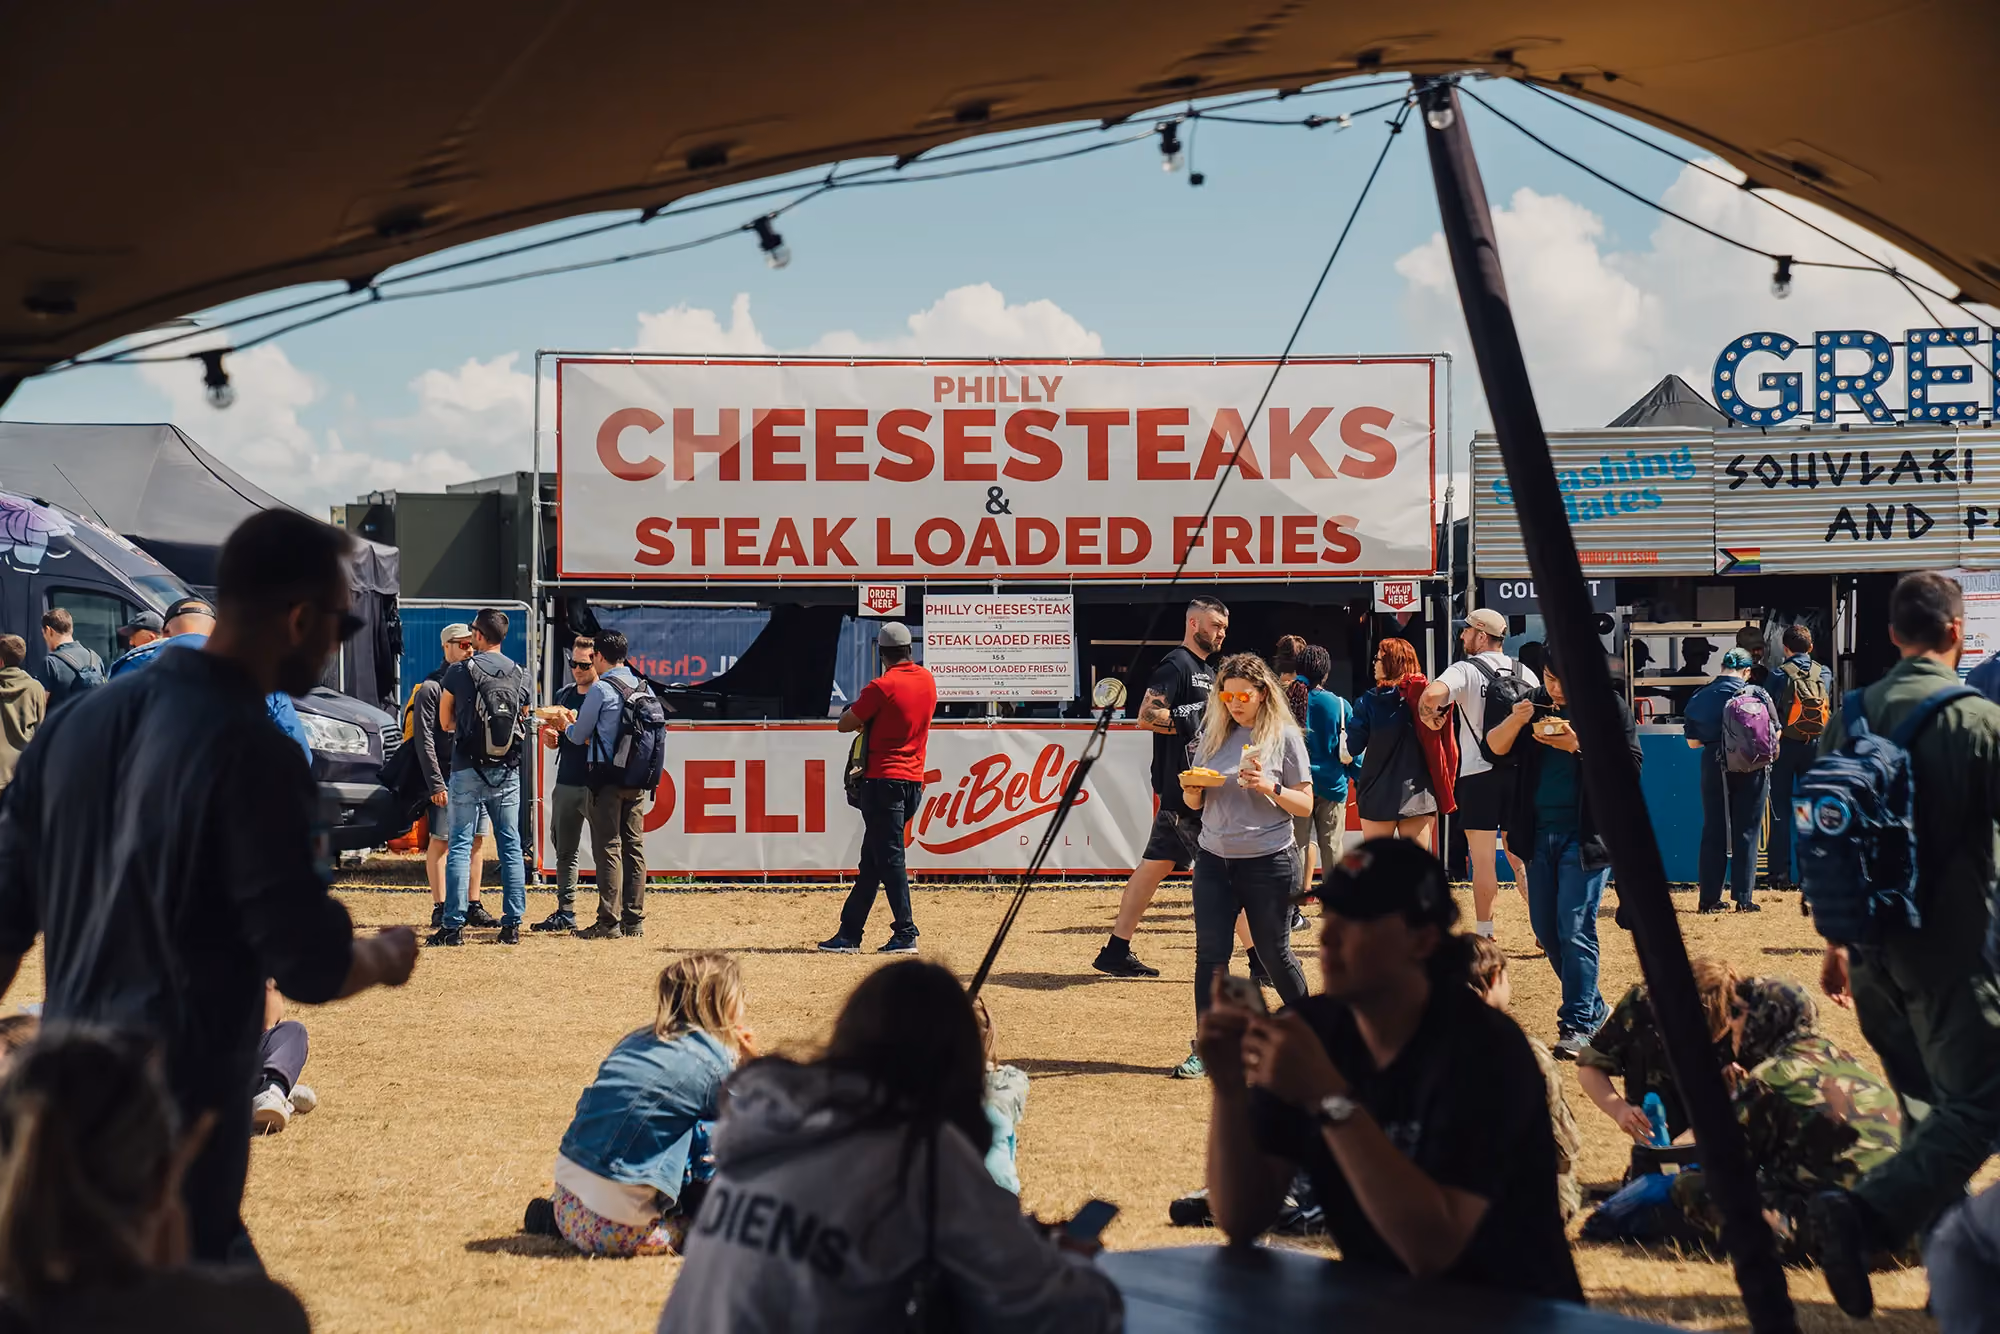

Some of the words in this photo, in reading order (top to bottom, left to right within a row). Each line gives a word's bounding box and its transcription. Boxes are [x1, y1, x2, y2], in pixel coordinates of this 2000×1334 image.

[934, 376, 1062, 403] PHILLY
[1713, 327, 2000, 426] GRE
[596, 406, 1398, 482] CHEESESTEAKS
[1491, 446, 1696, 504] Sashing
[1726, 448, 1974, 490] SOUVLAKI
[986, 486, 1012, 514] &
[1562, 487, 1663, 525] lates
[1824, 503, 1936, 542] AND
[1963, 505, 2000, 541] F
[634, 516, 858, 567] STEAK
[876, 516, 1153, 567] LOADED
[1173, 514, 1362, 565] FRIES
[869, 589, 896, 599] ORDER
[1384, 585, 1412, 595] PICK-UP
[1388, 595, 1409, 605] HERE
[1500, 580, 1601, 599] COLT
[872, 599, 893, 609] HERE
[925, 604, 971, 616] PHILLY
[975, 603, 1071, 616] CHEESESTEAK
[928, 633, 971, 646] STEAK
[975, 633, 1030, 646] LOADED
[1033, 633, 1071, 646] FRIES
[930, 664, 987, 674] MUSHROOM
[989, 664, 1026, 674] LOADED
[1028, 664, 1054, 673] FRIES
